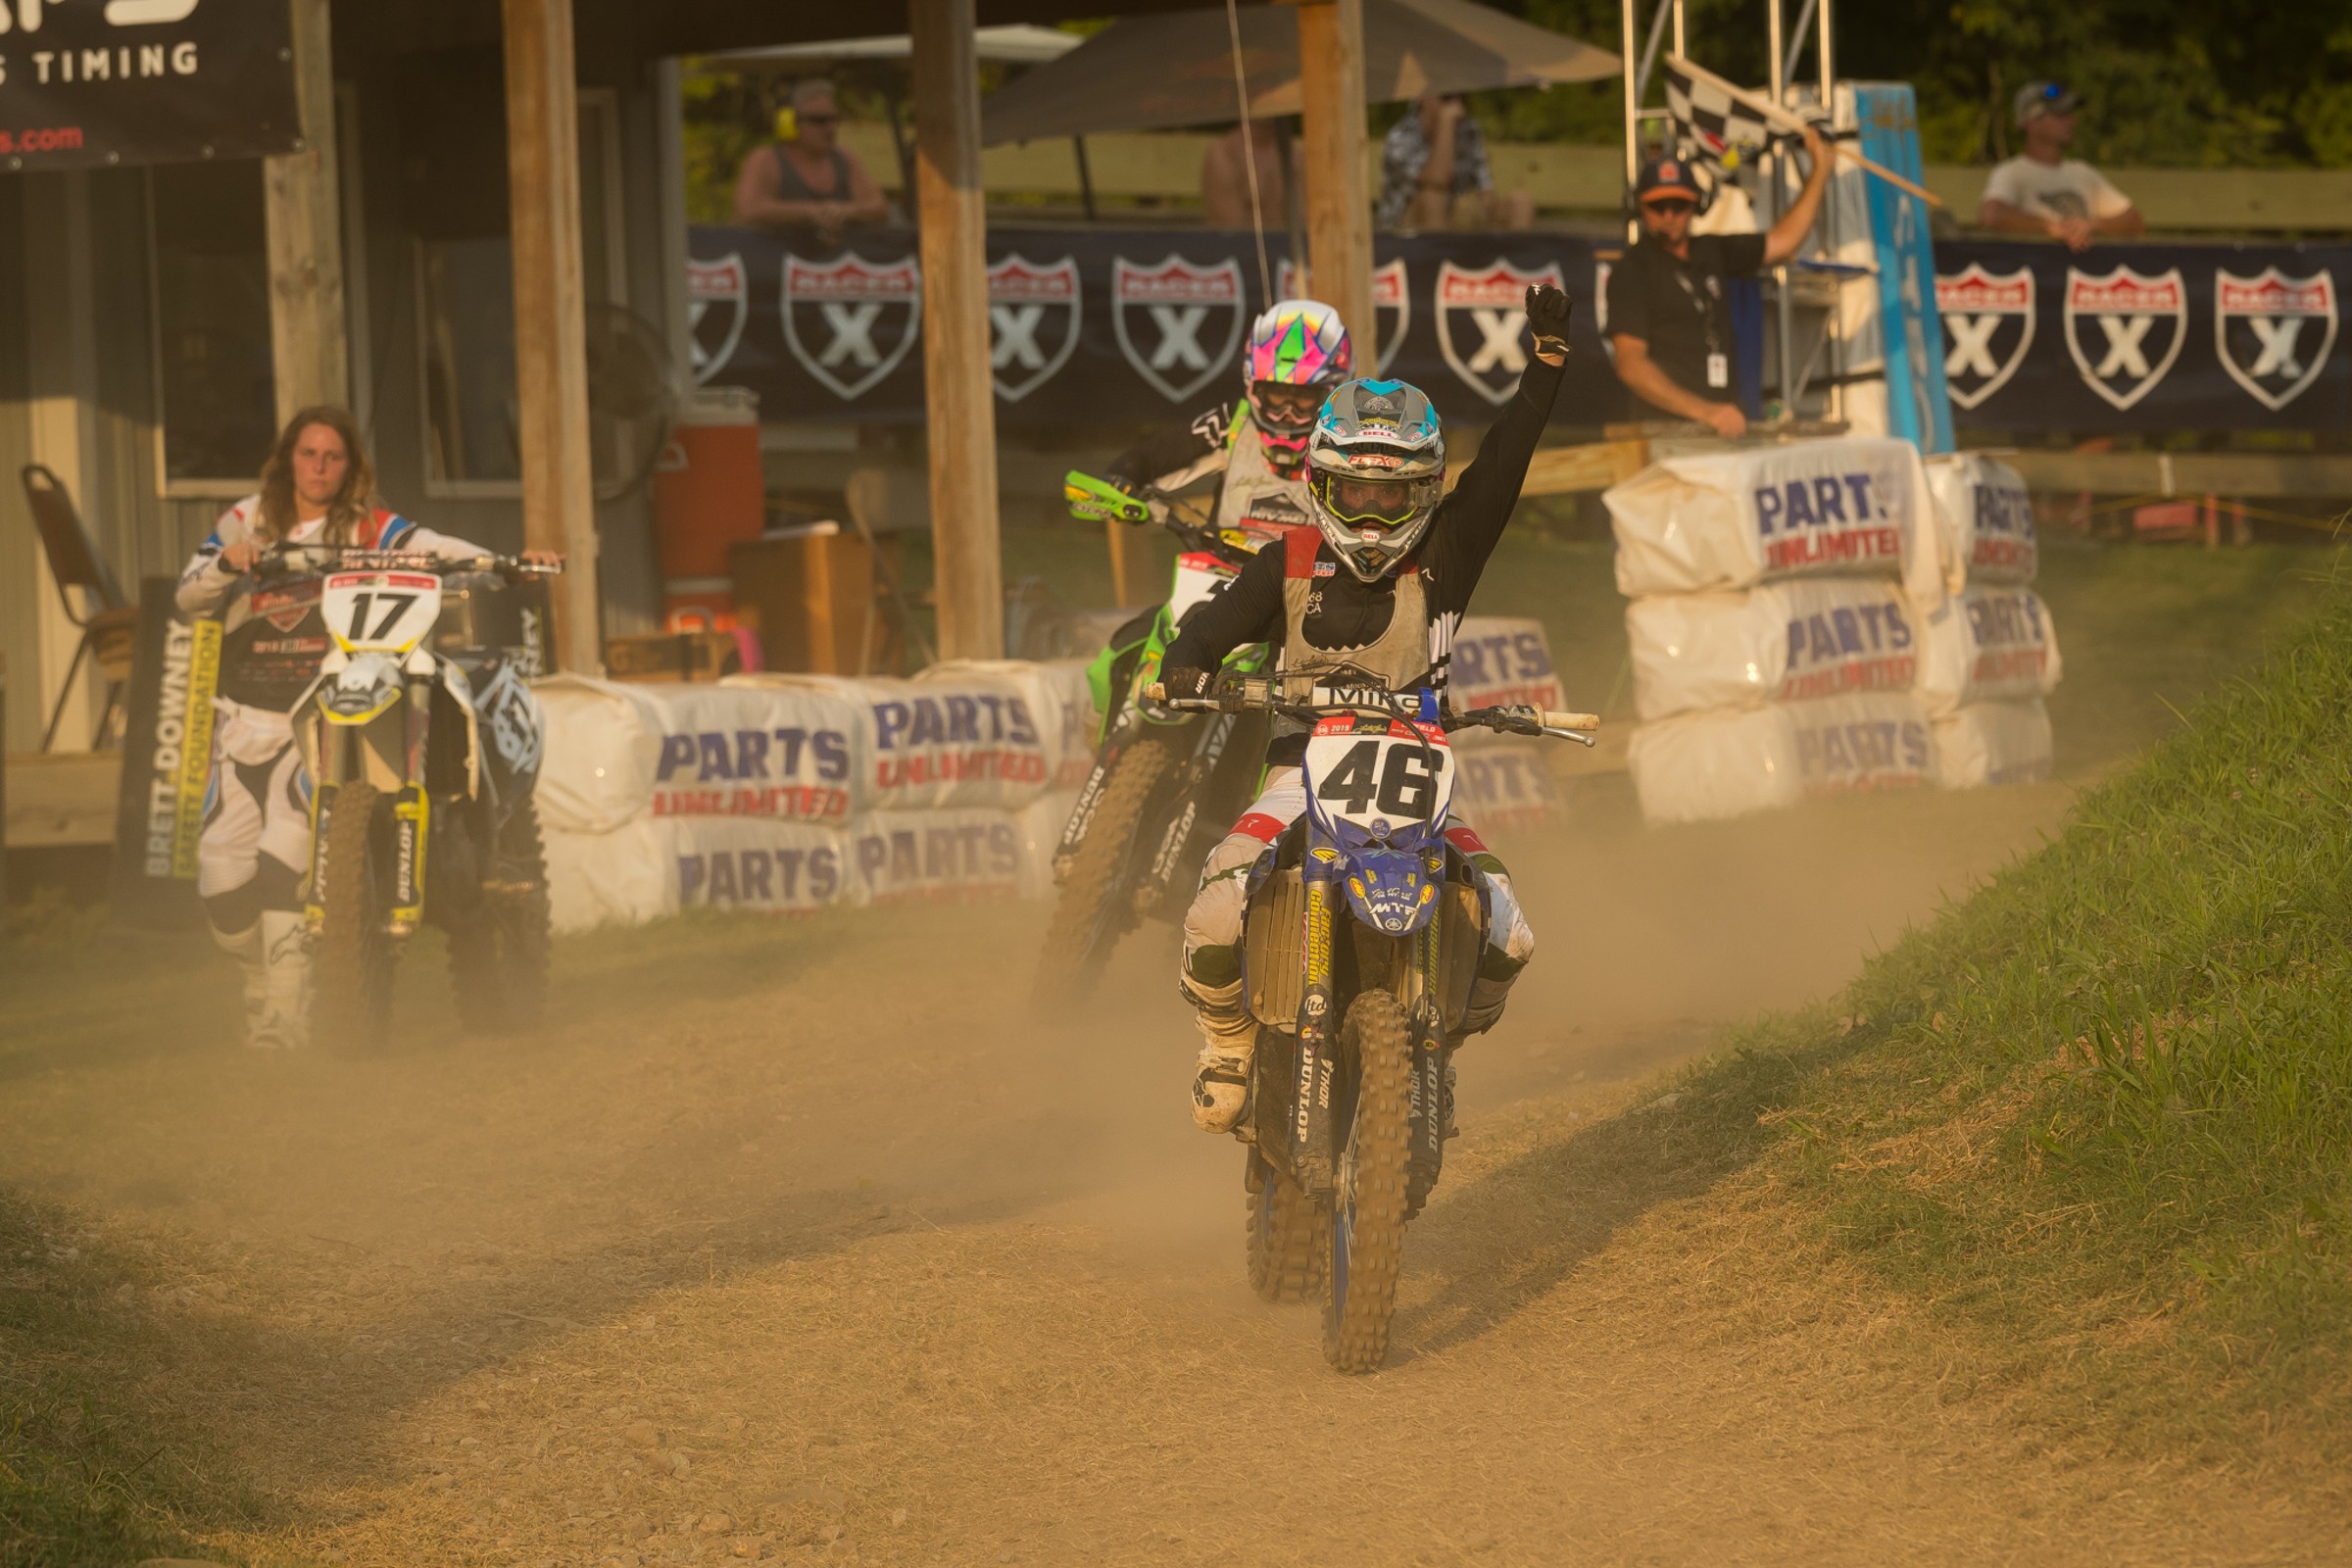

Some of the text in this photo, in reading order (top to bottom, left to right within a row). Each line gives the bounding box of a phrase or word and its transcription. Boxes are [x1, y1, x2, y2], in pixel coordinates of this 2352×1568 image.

[32, 41, 198, 84] TIMING
[819, 303, 882, 367] X
[991, 305, 1045, 369] X
[1149, 307, 1209, 370] X
[1472, 309, 1529, 372] X
[1944, 315, 2001, 377] X
[2096, 316, 2154, 378] X
[2248, 317, 2304, 379] X
[1755, 473, 1887, 535] PART
[348, 592, 420, 641] 17
[1787, 602, 1912, 670] PARTS
[1449, 633, 1553, 686] RTS
[146, 617, 195, 876] BRETT DOWNEY
[874, 695, 1040, 750] PARTS
[656, 727, 850, 782] PARTS
[1318, 740, 1445, 820] 46
[677, 847, 840, 905] PARTS
[857, 824, 1018, 886] PARTS
[1298, 1047, 1314, 1143] DUNLOP
[1318, 1072, 1334, 1109] THOR
[1427, 1056, 1441, 1154] DUNLOP
